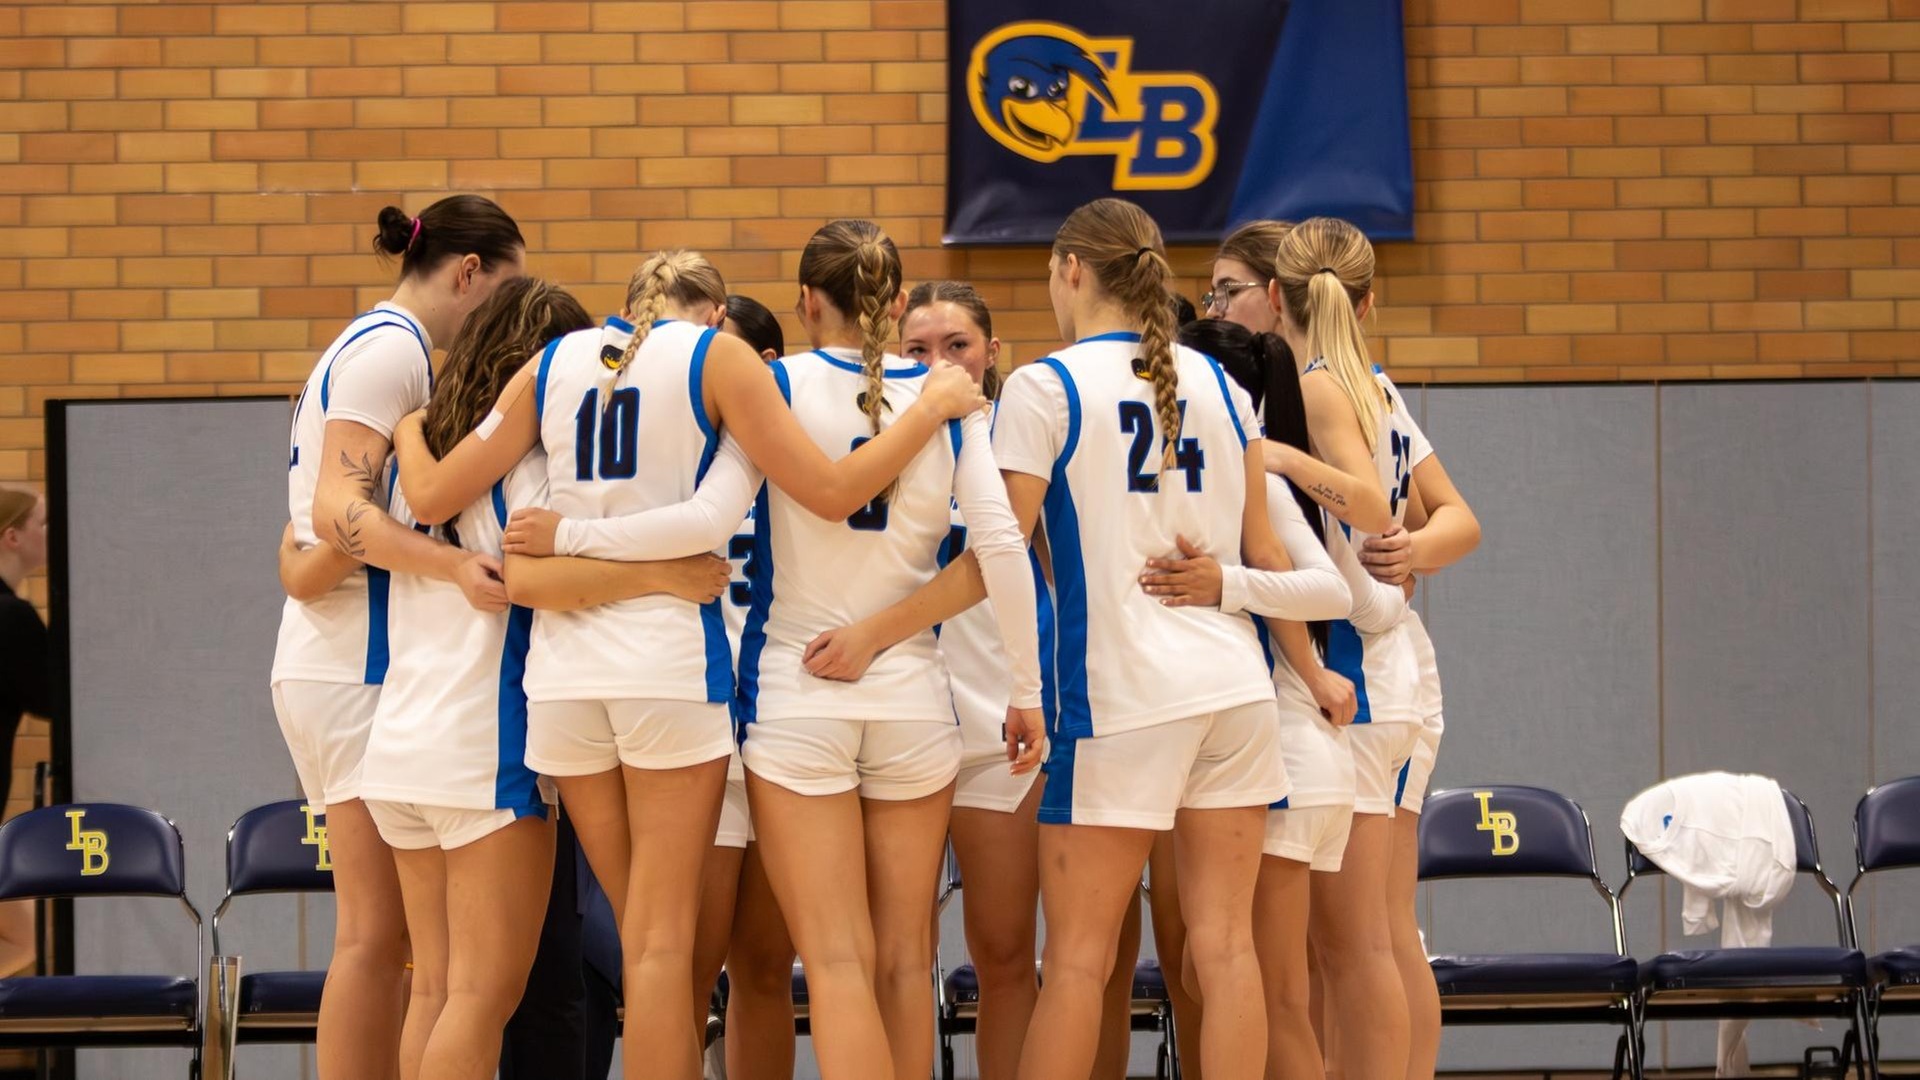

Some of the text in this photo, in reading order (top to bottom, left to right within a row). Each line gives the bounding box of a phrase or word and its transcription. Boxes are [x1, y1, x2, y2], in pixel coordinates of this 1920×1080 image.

[575, 387, 640, 481] 10
[1118, 399, 1204, 493] 24
[65, 811, 109, 876] LB
[1473, 791, 1520, 856] LB
